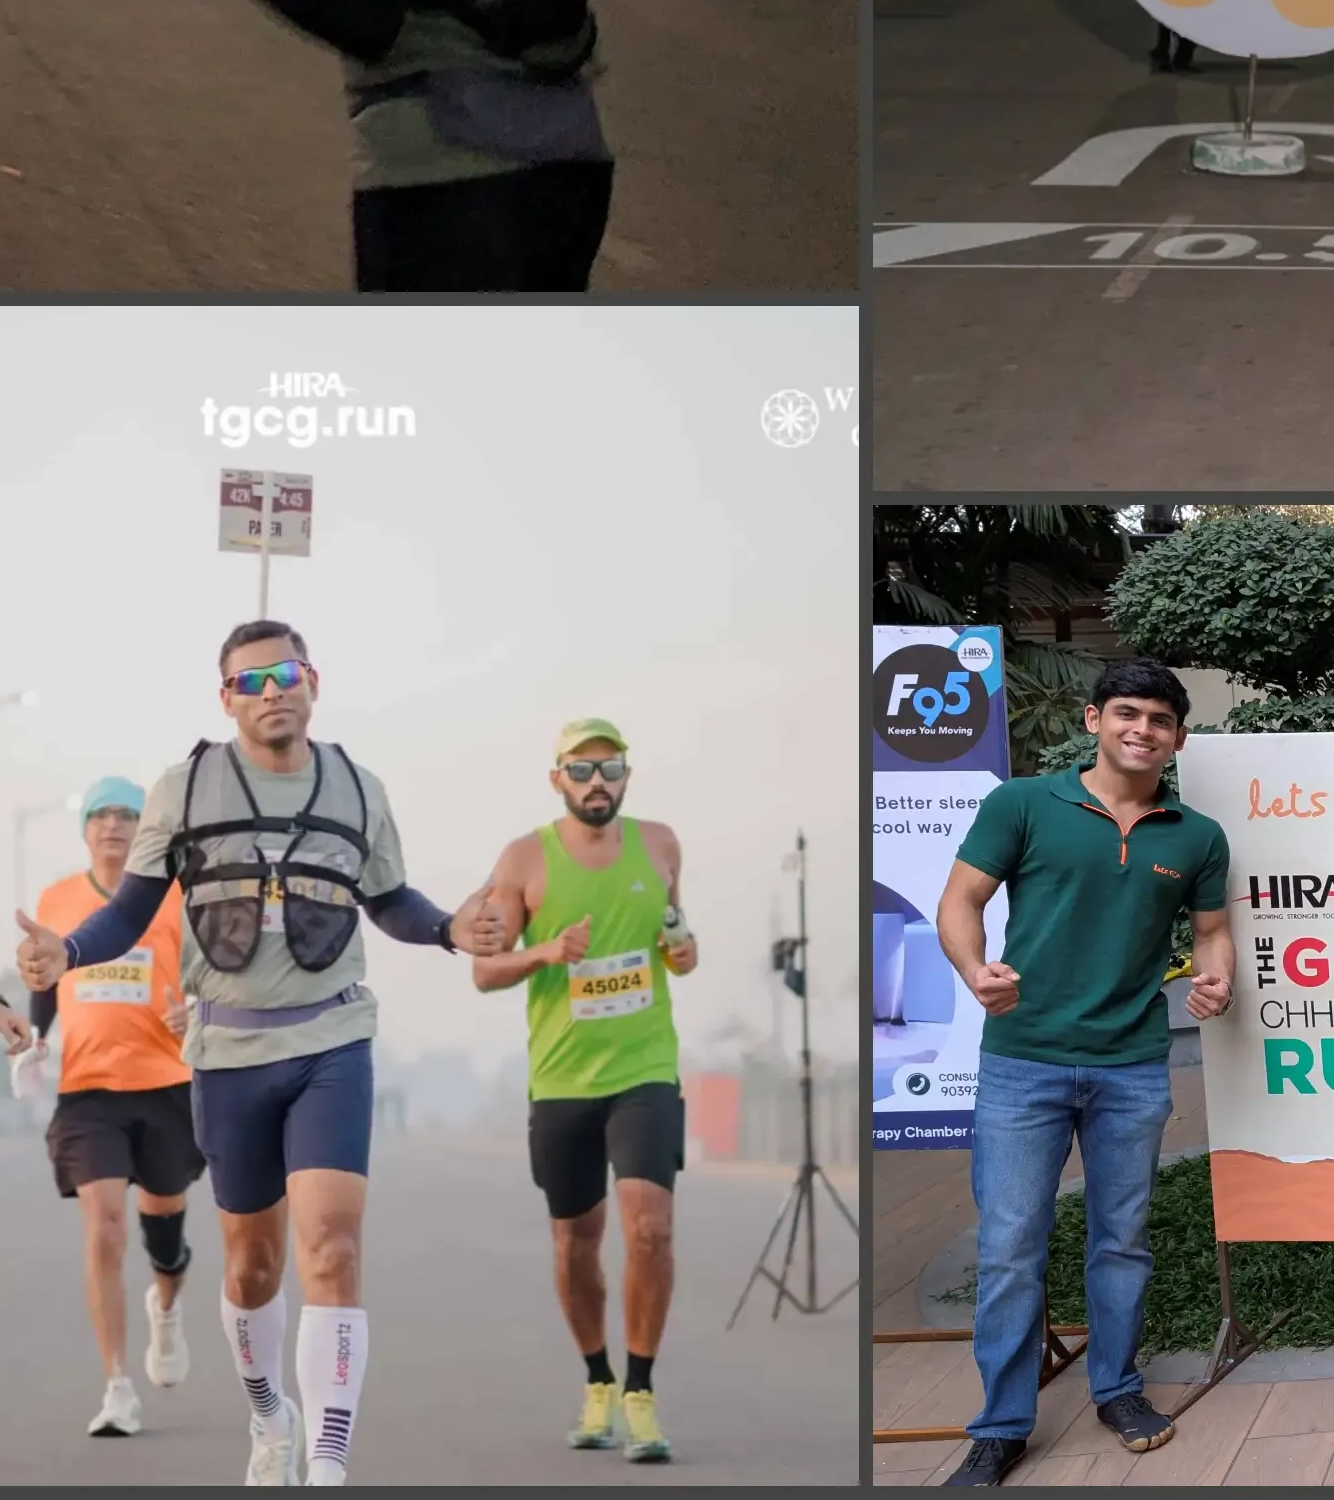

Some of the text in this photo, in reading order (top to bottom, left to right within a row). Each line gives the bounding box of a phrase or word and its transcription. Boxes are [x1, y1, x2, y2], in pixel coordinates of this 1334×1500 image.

[229, 488, 251, 504] 42K
[248, 519, 282, 537] PAER
[963, 647, 988, 657] HIRA
[886, 671, 971, 727] F95
[887, 726, 973, 737] Keeps You Moving
[875, 796, 932, 810] Better
[1247, 777, 1329, 820] lets
[873, 820, 953, 837] cool way
[1286, 912, 1319, 920] STRONGER
[1254, 936, 1276, 989] THE
[582, 972, 643, 996] 45024
[904, 1126, 968, 1138] Chamber
[333, 1323, 354, 1386] Leosportz
